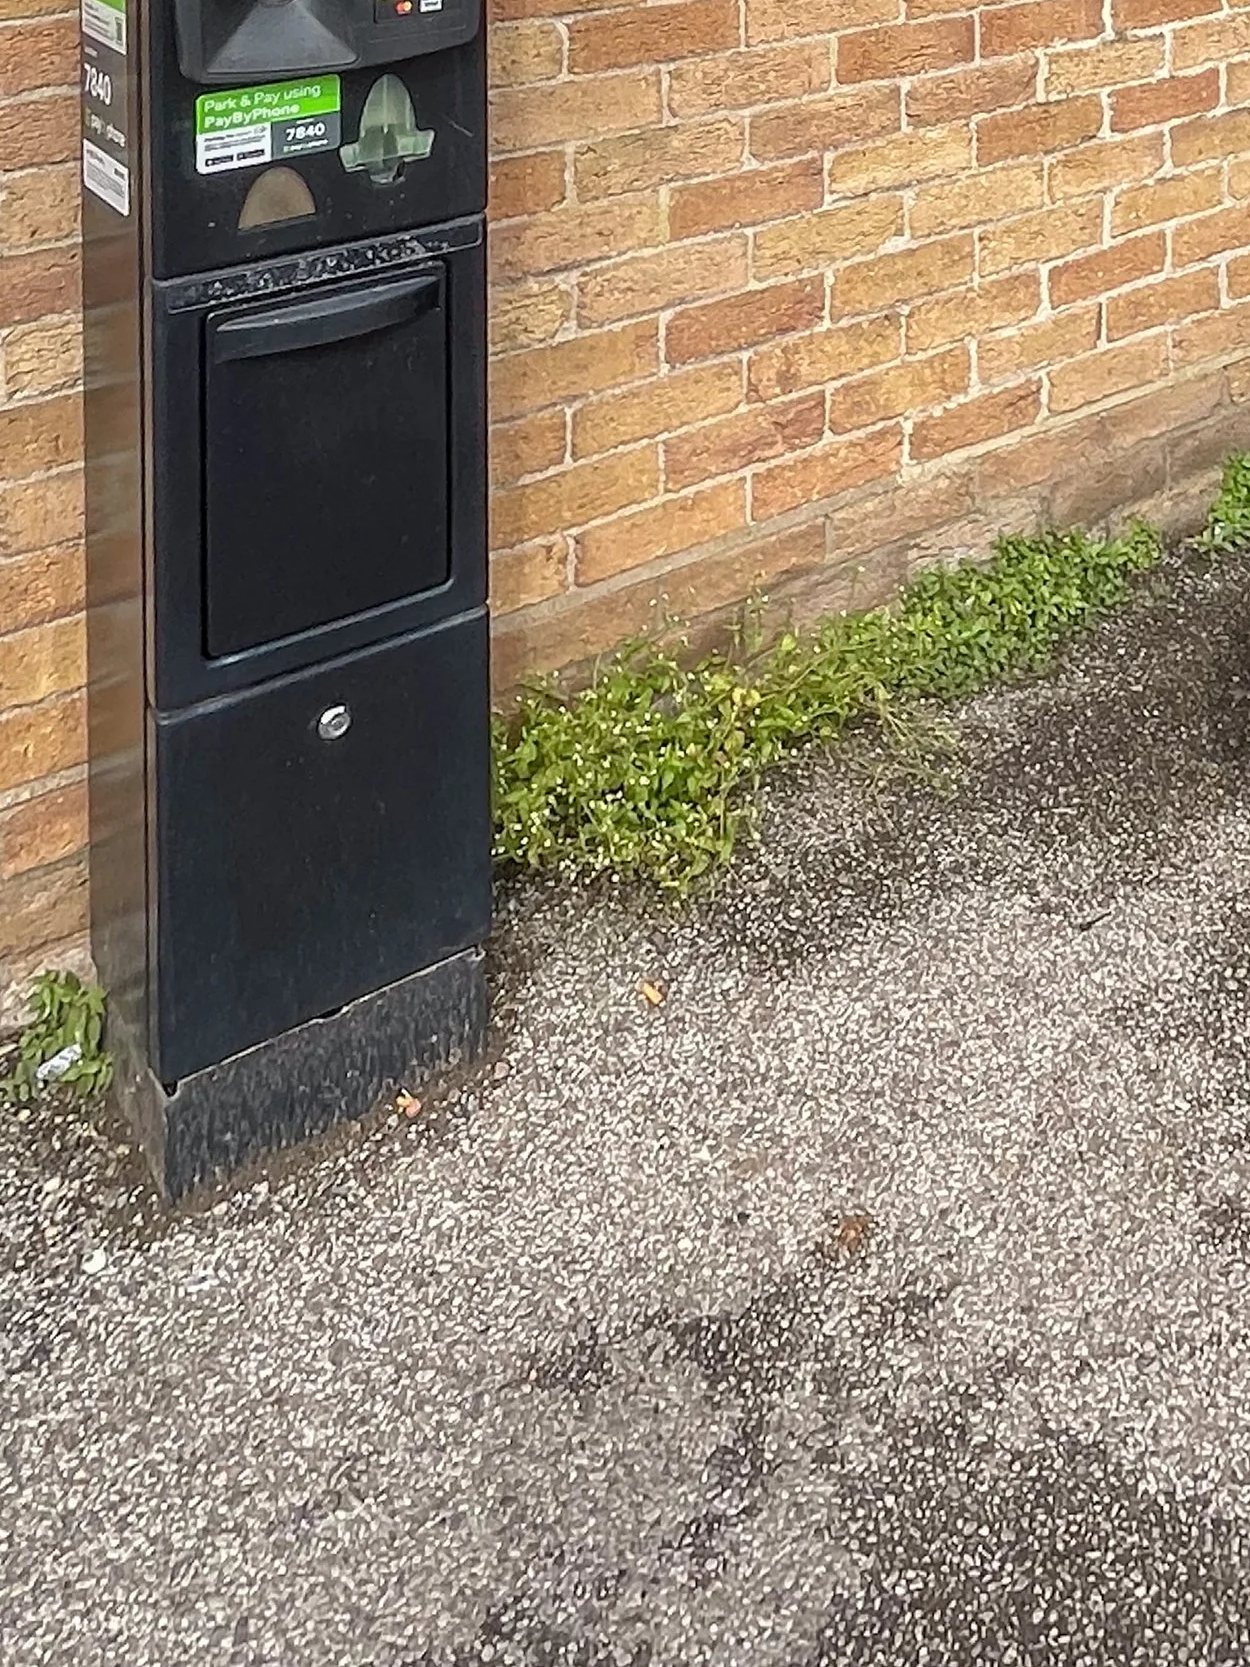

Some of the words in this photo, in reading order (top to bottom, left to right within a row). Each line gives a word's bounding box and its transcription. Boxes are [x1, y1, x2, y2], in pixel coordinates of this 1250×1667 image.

[83, 62, 112, 106] 7840
[204, 97, 237, 113] Park
[239, 95, 251, 108] &
[254, 91, 281, 106] Pay
[283, 84, 321, 98] using
[204, 103, 300, 129] PayByPhone
[285, 122, 326, 141] 7840
